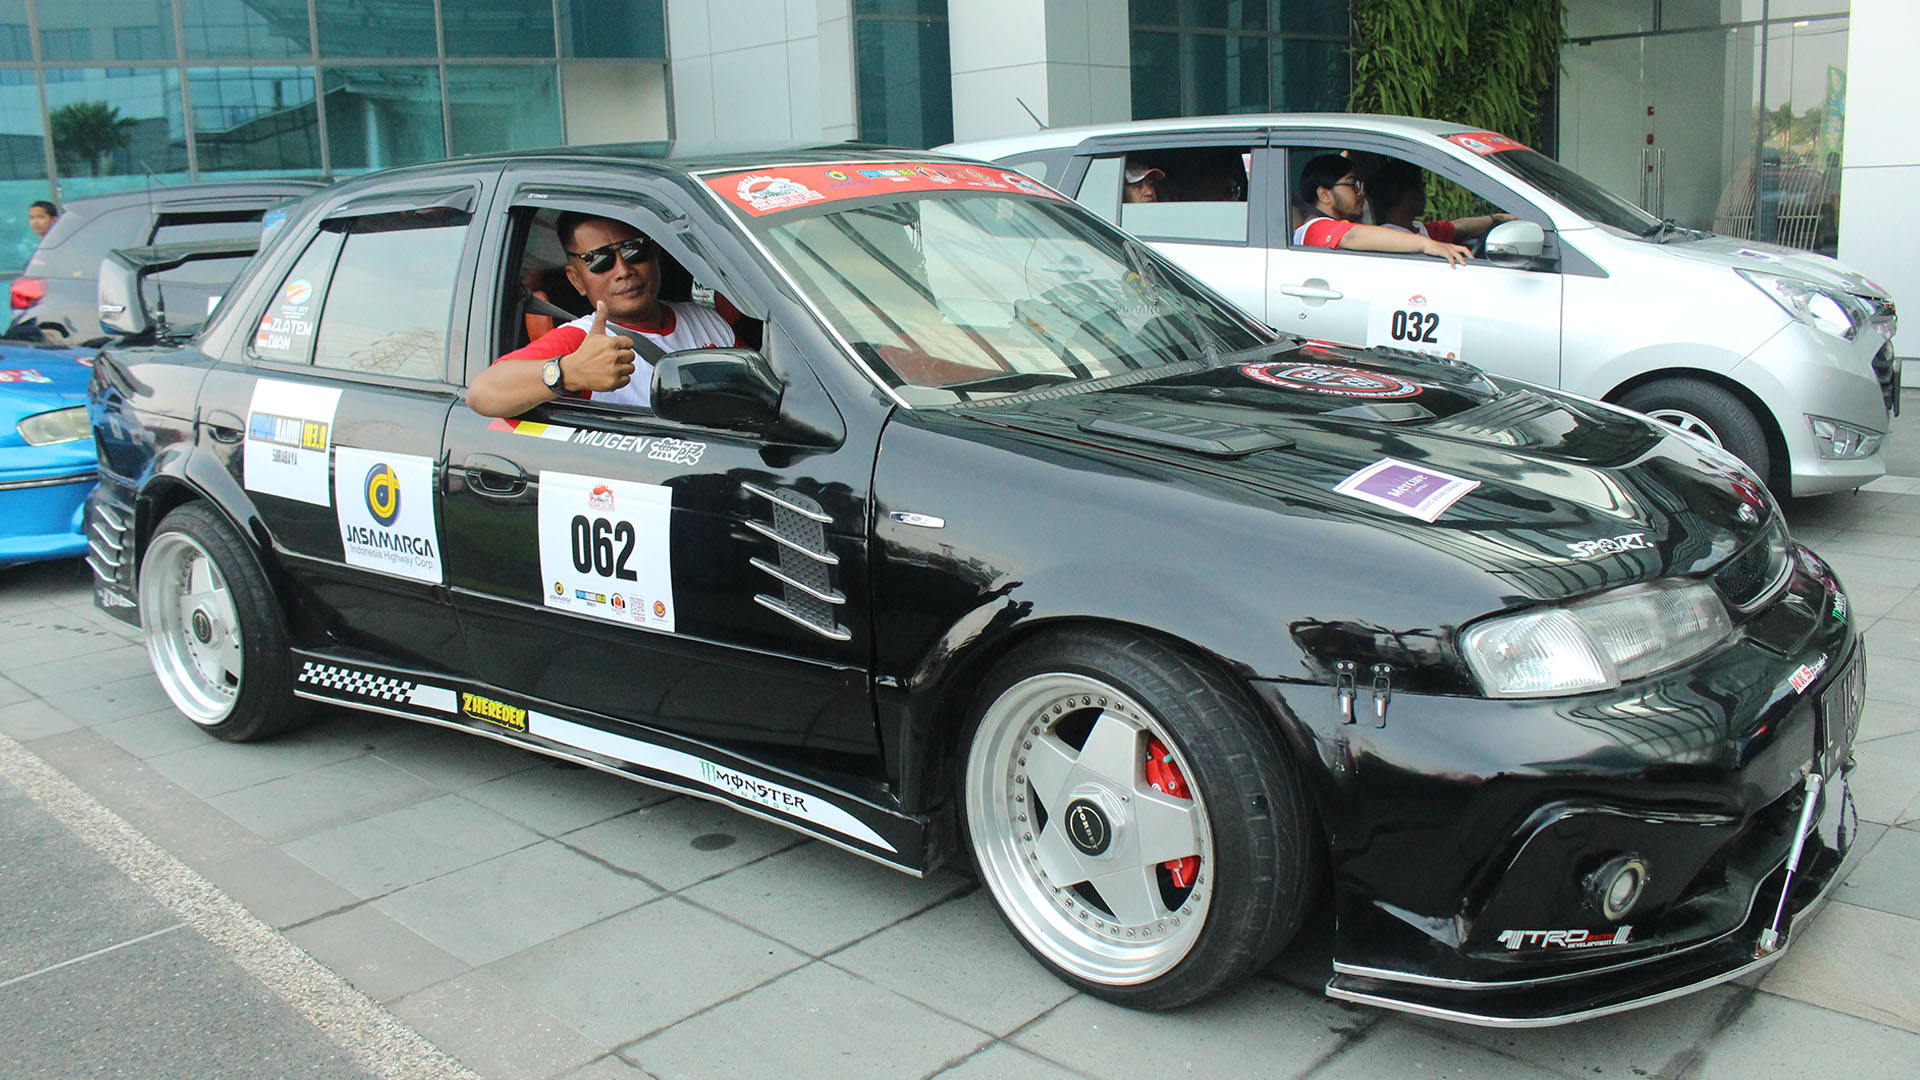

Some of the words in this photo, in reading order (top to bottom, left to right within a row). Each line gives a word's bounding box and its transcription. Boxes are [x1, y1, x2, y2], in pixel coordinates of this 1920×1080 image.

[1391, 310, 1439, 343] 032
[573, 429, 651, 453] MUGEN
[1387, 474, 1428, 498] Mercure
[347, 524, 434, 558] JASAMARGA
[350, 544, 382, 559] Indonesia
[383, 549, 413, 567] Highway
[571, 515, 637, 582] 062
[716, 769, 808, 812] MONSTER
[730, 786, 791, 812] ENERGY
